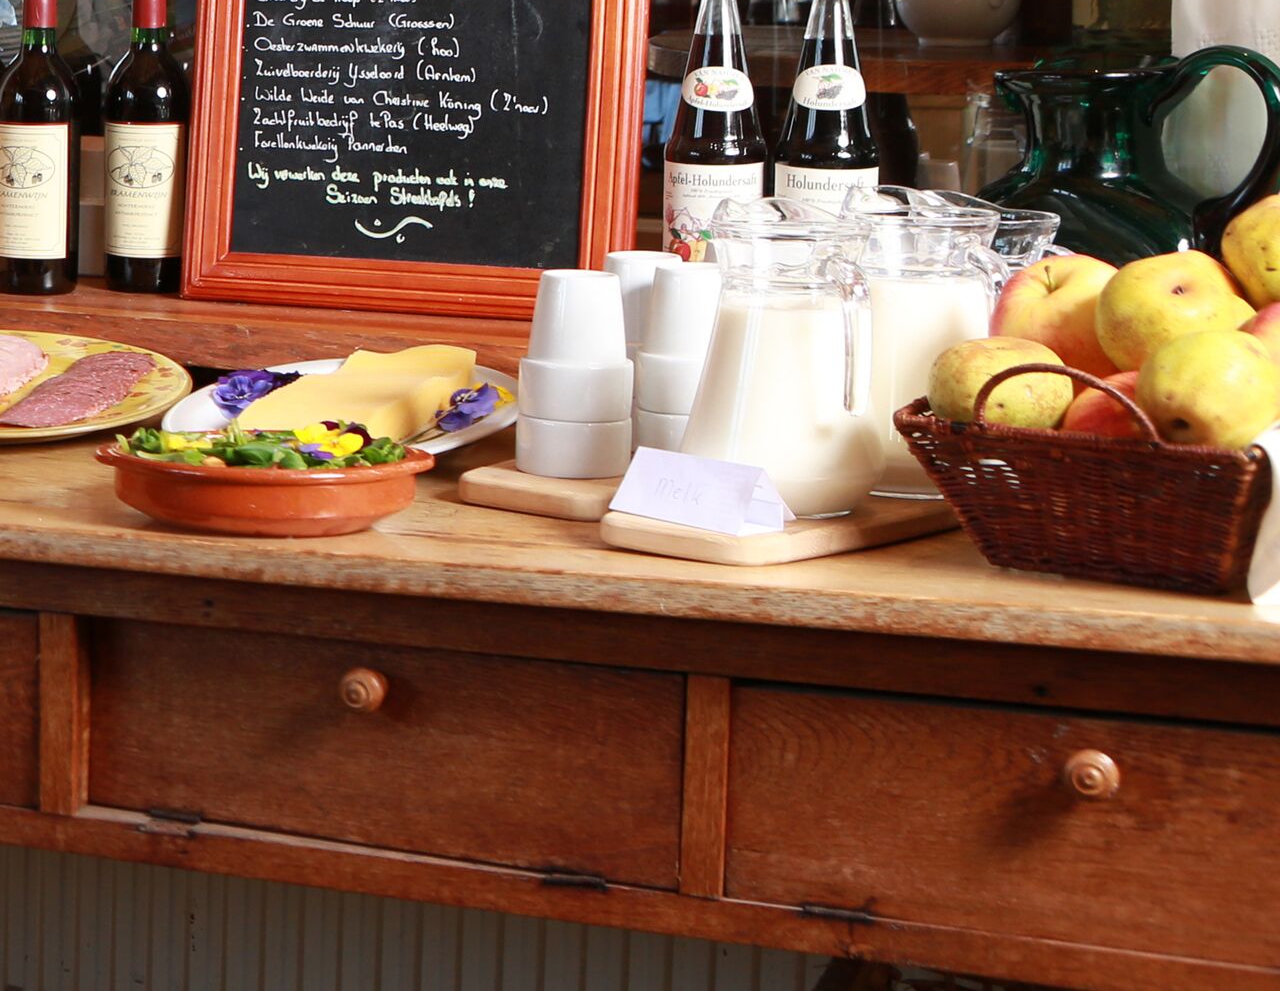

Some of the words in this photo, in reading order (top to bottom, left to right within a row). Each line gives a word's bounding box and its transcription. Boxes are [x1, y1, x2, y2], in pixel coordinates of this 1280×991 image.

[252, 11, 276, 27] De
[332, 13, 376, 28] Schuur
[255, 86, 293, 102] Wilde
[343, 95, 365, 105] van
[248, 161, 270, 189] Wij
[464, 171, 475, 187] in
